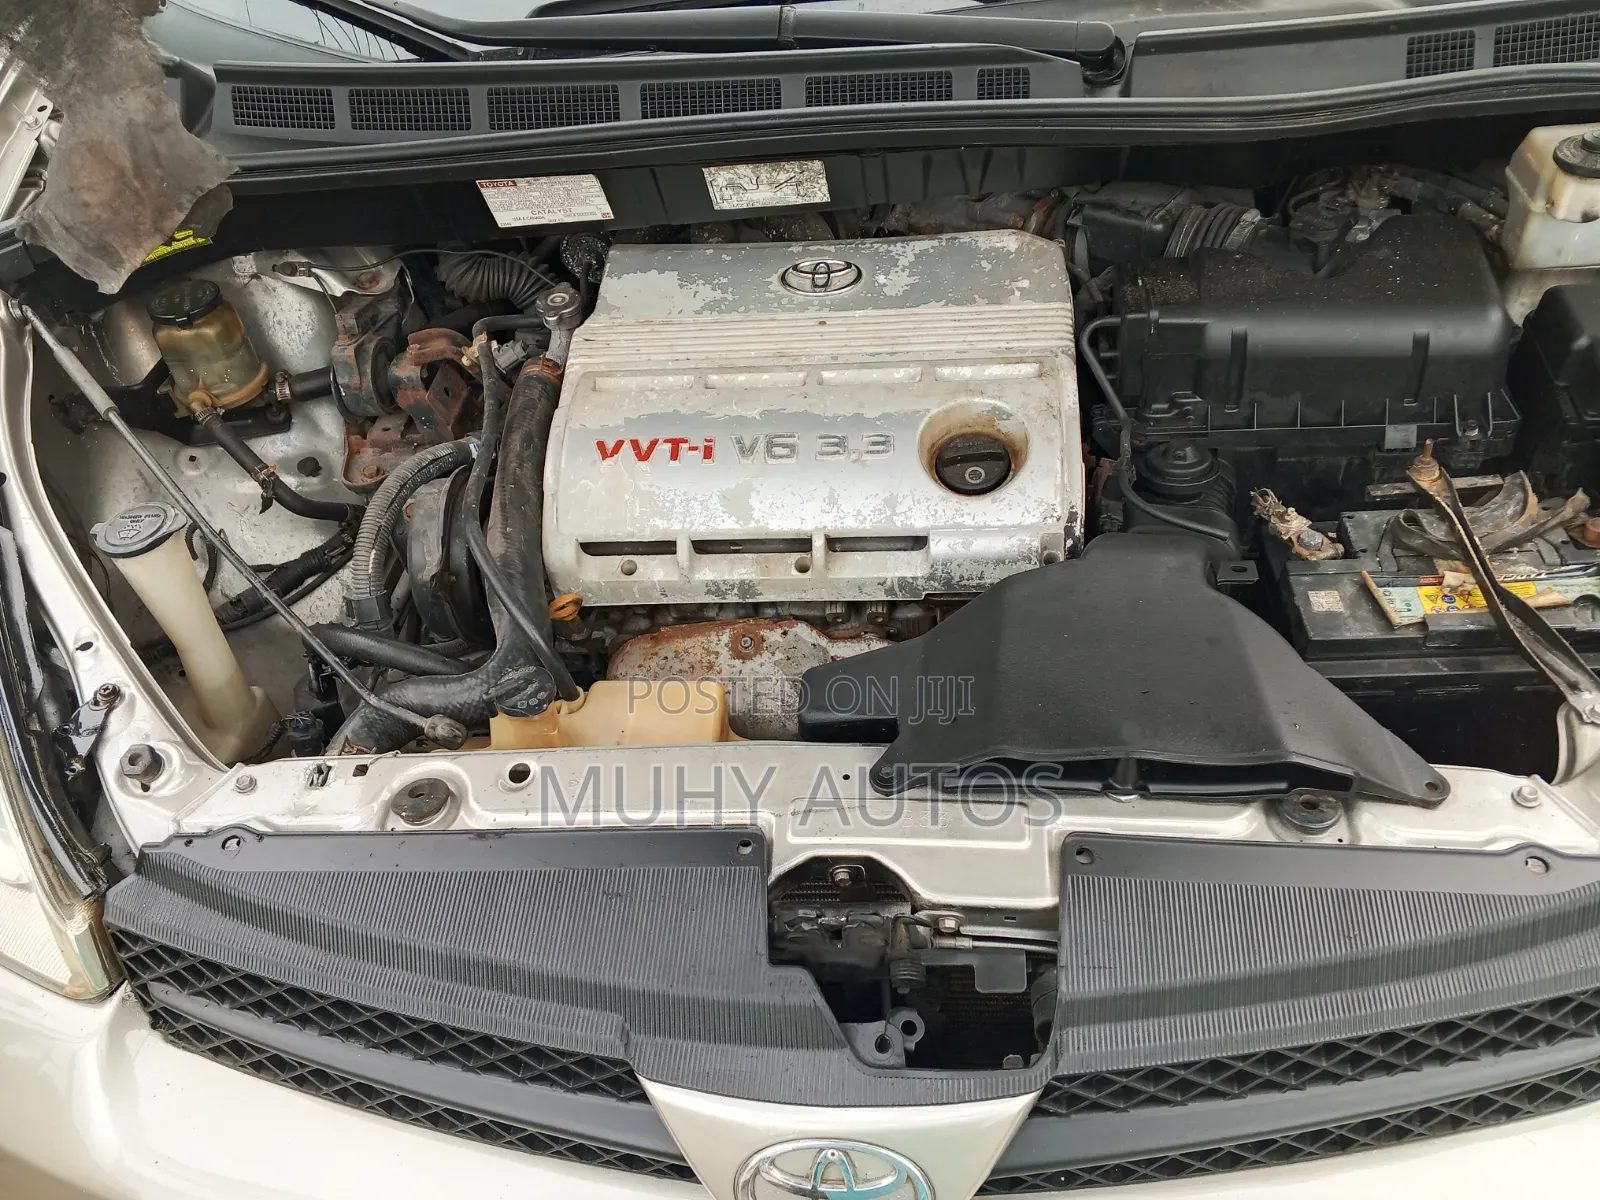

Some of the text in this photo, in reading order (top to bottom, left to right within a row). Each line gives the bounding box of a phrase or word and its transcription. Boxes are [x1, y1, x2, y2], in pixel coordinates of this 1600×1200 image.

[481, 180, 515, 188] TOYOTA
[531, 207, 573, 216] CATALYST
[595, 437, 716, 466] VVT-i
[730, 432, 800, 464] V6
